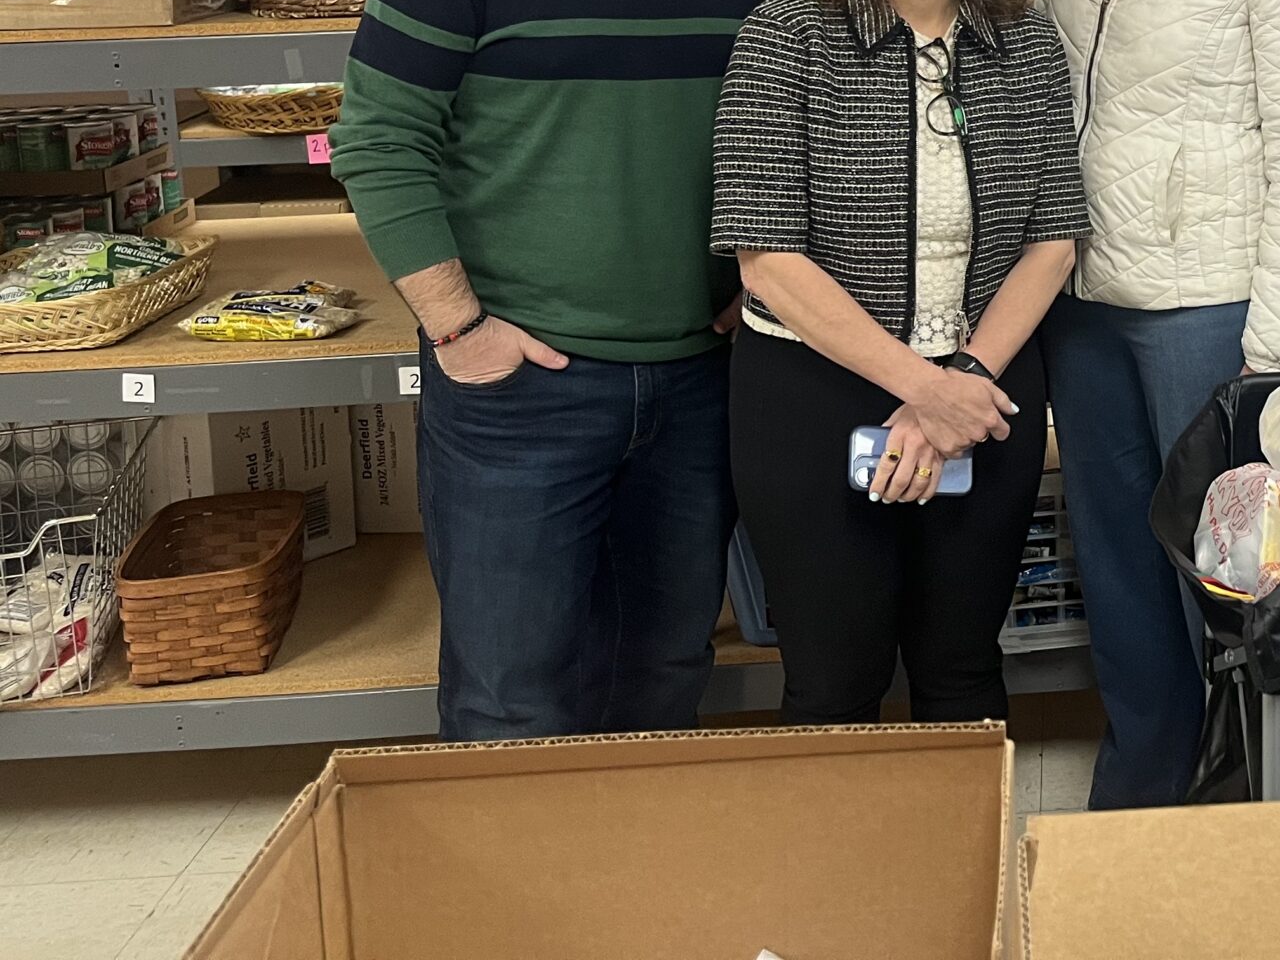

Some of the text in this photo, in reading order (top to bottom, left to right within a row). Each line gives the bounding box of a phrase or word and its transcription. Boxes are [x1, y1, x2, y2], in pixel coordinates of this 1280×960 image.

[312, 139, 321, 152] 2
[134, 382, 144, 396] 2
[410, 374, 420, 388] 2
[373, 404, 386, 438] Vegetab
[260, 420, 274, 490] ixed Vegetables
[358, 418, 372, 479] Deerfield
[375, 441, 386, 467] Mixed
[246, 453, 257, 490] rfield
